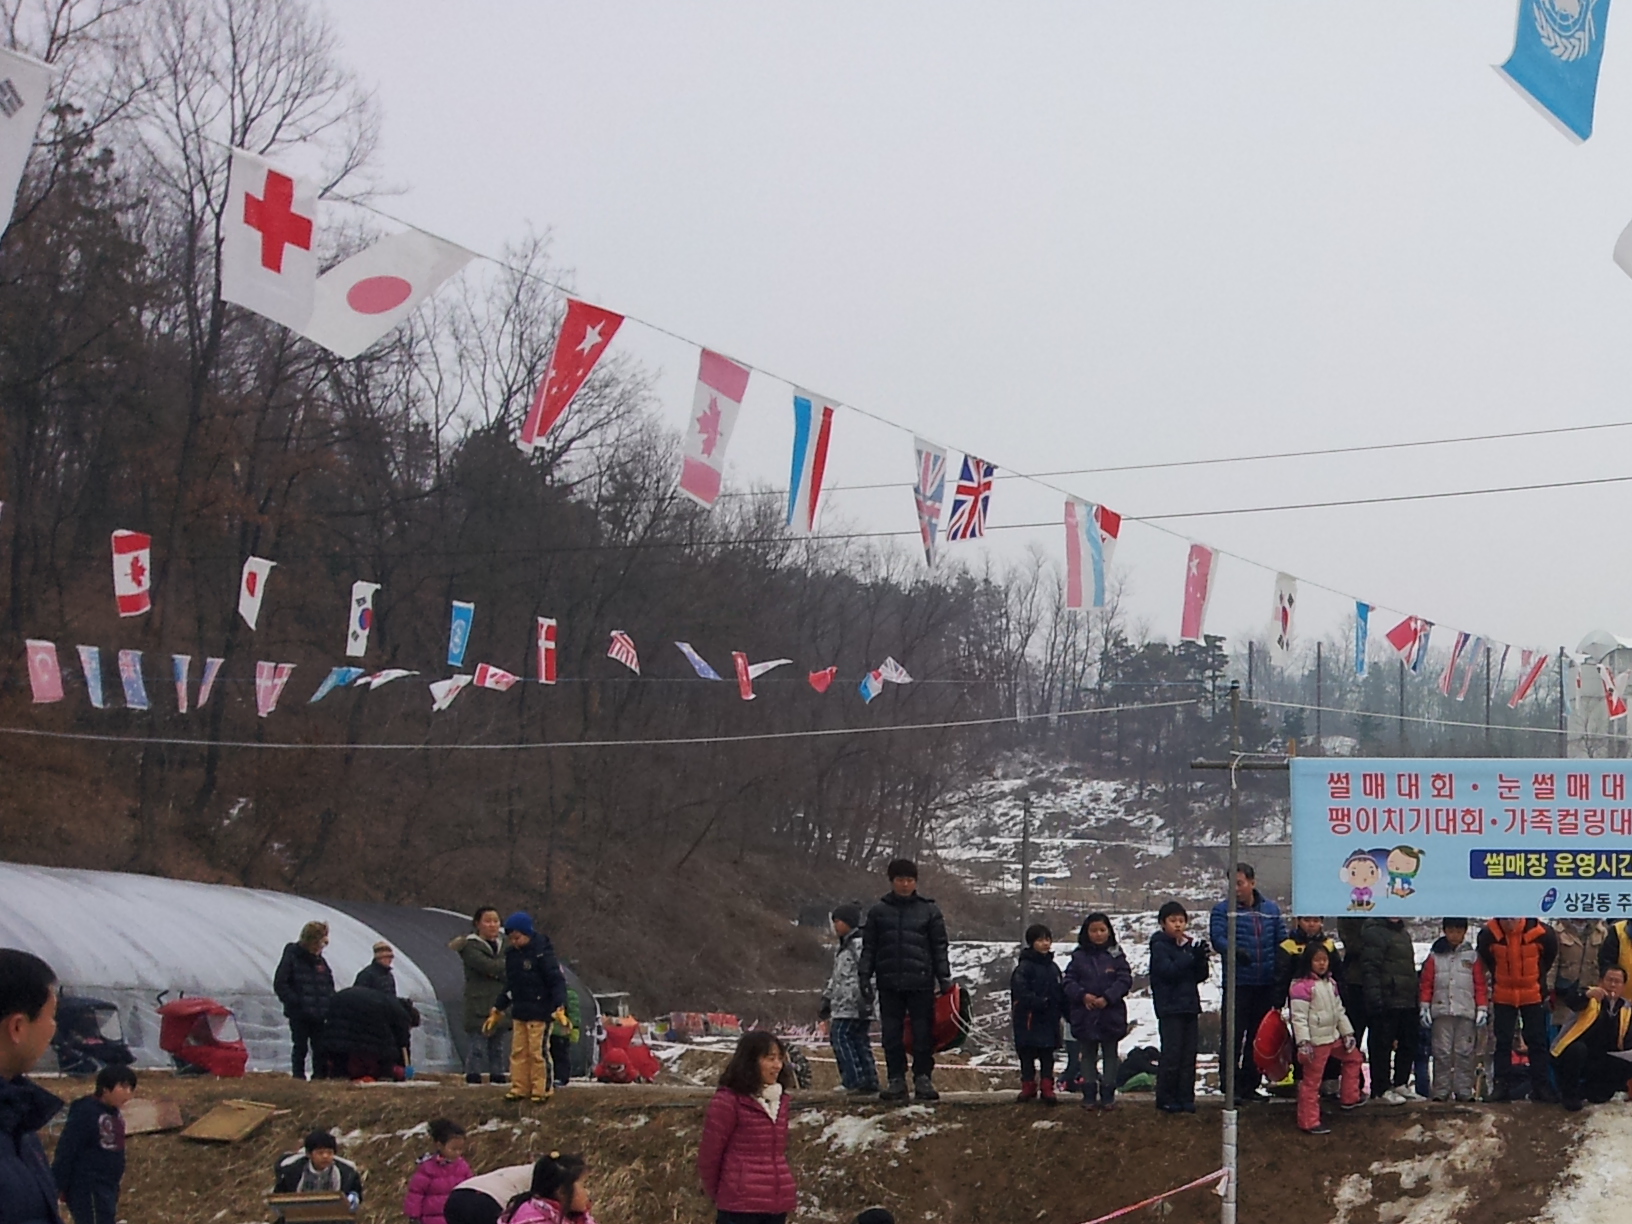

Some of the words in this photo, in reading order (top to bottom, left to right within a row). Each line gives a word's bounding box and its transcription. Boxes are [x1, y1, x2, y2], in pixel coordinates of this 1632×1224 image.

[1327, 773, 1454, 800] 썰매대회
[1483, 852, 1549, 877] 썰매장
[1564, 892, 1612, 913] 상갈동
